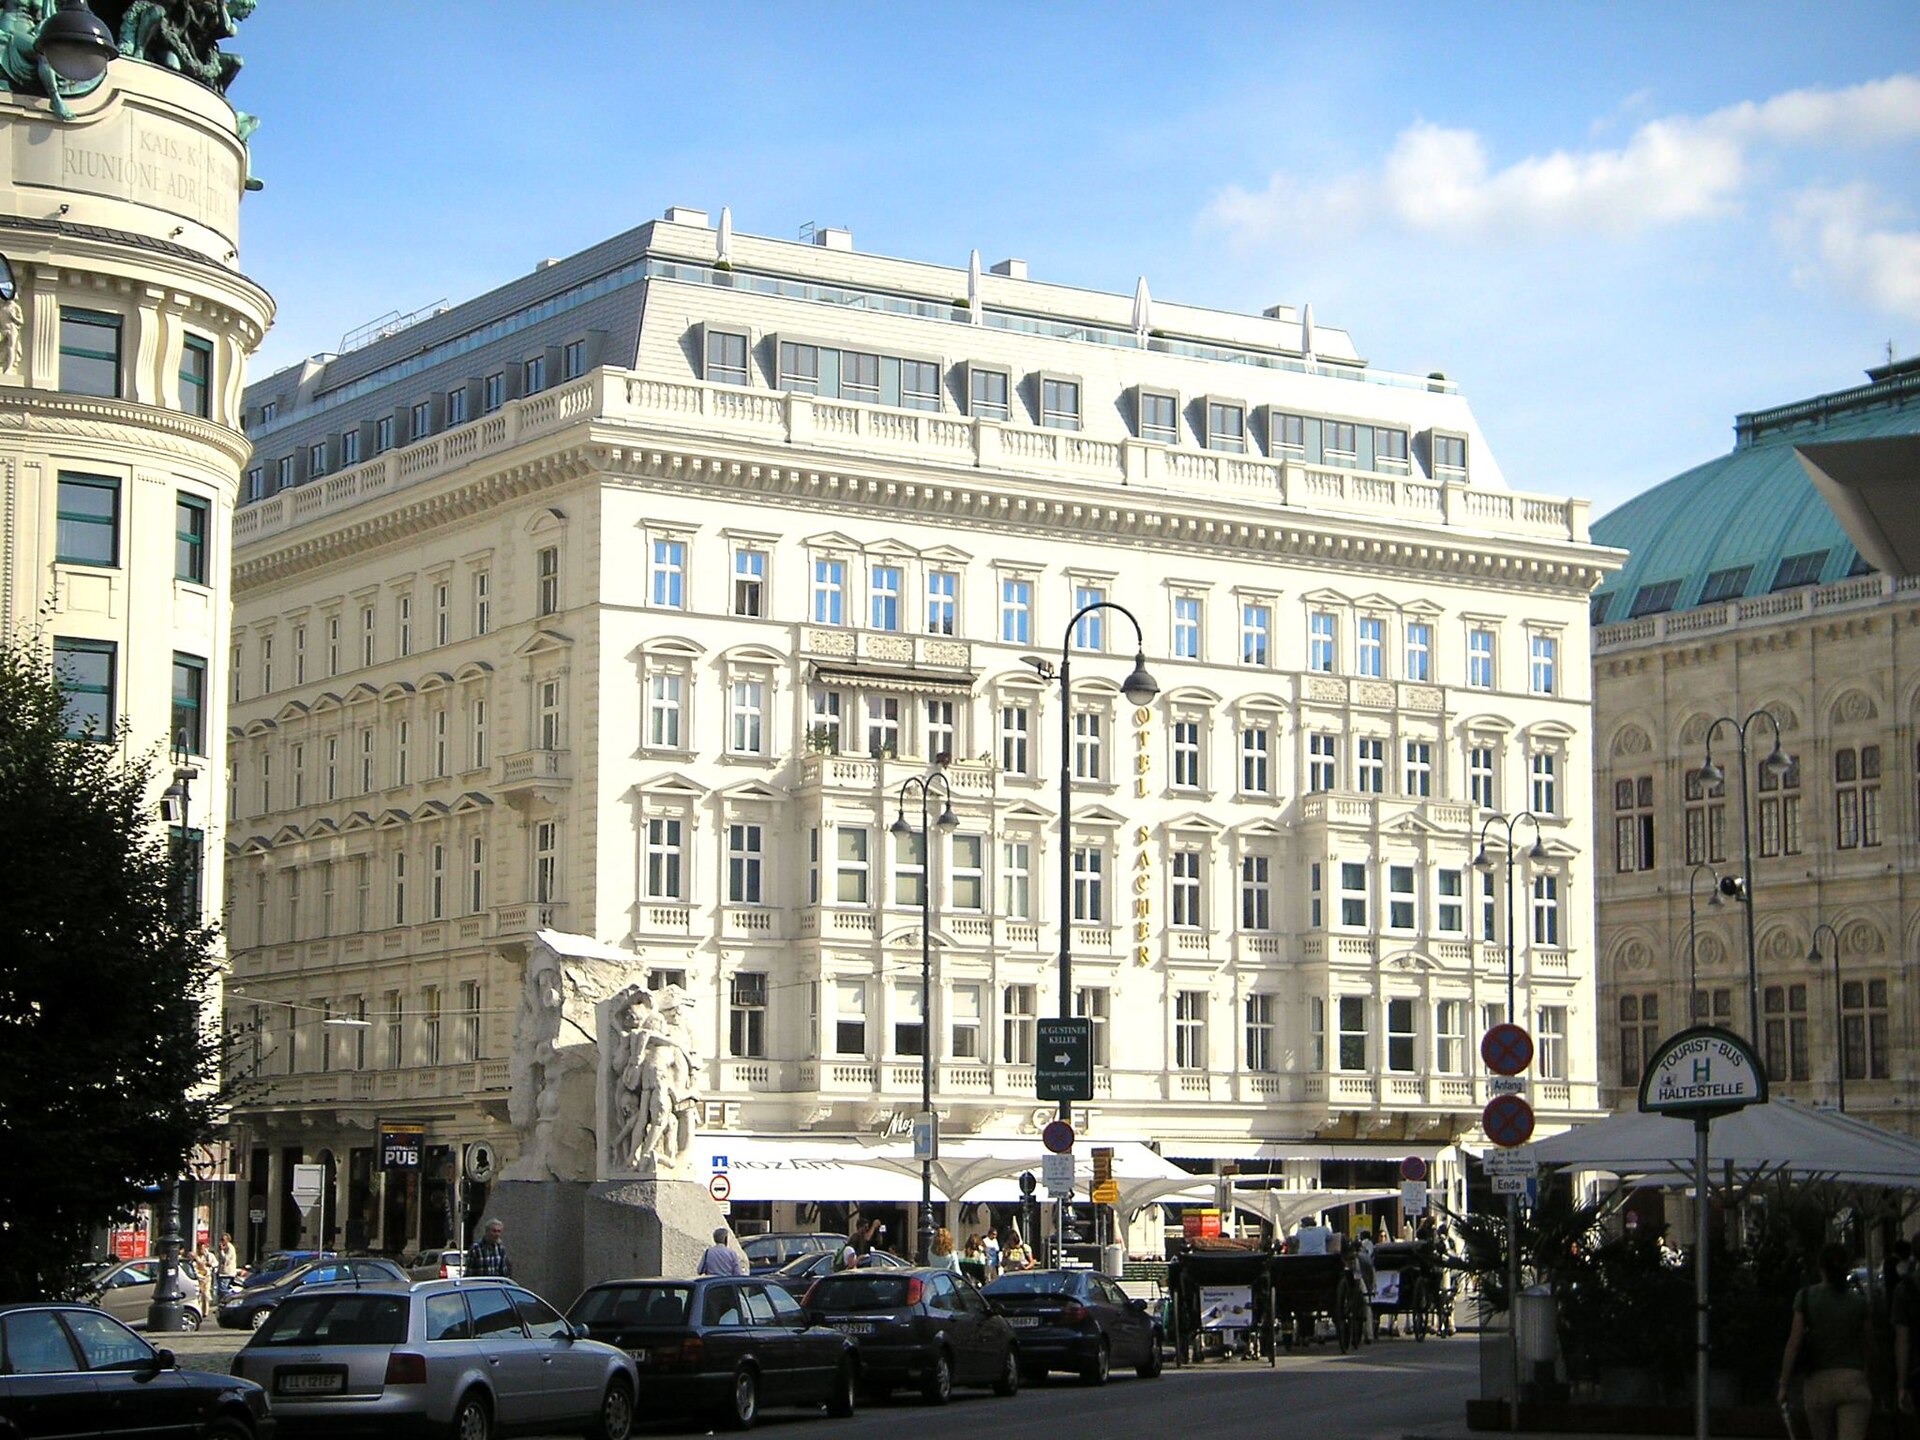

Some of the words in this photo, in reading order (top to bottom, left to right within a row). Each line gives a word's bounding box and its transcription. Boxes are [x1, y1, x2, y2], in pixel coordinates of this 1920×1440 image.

[64, 148, 162, 192] RIUNIONE
[1134, 705, 1150, 798] OTEL
[1134, 825, 1150, 968] SACHER
[1040, 1026, 1087, 1034] AUGUSTINER
[1049, 1036, 1077, 1044] KELLER
[1693, 1057, 1710, 1083] H
[1050, 1084, 1075, 1092] MUSIK
[1494, 1080, 1522, 1092] Anfang
[1659, 1082, 1744, 1100] HALTESTELLE
[880, 1112, 915, 1139] Moz
[384, 1151, 419, 1165] PUB
[727, 1158, 846, 1170] MOZART
[1497, 1179, 1521, 1190] Ende
